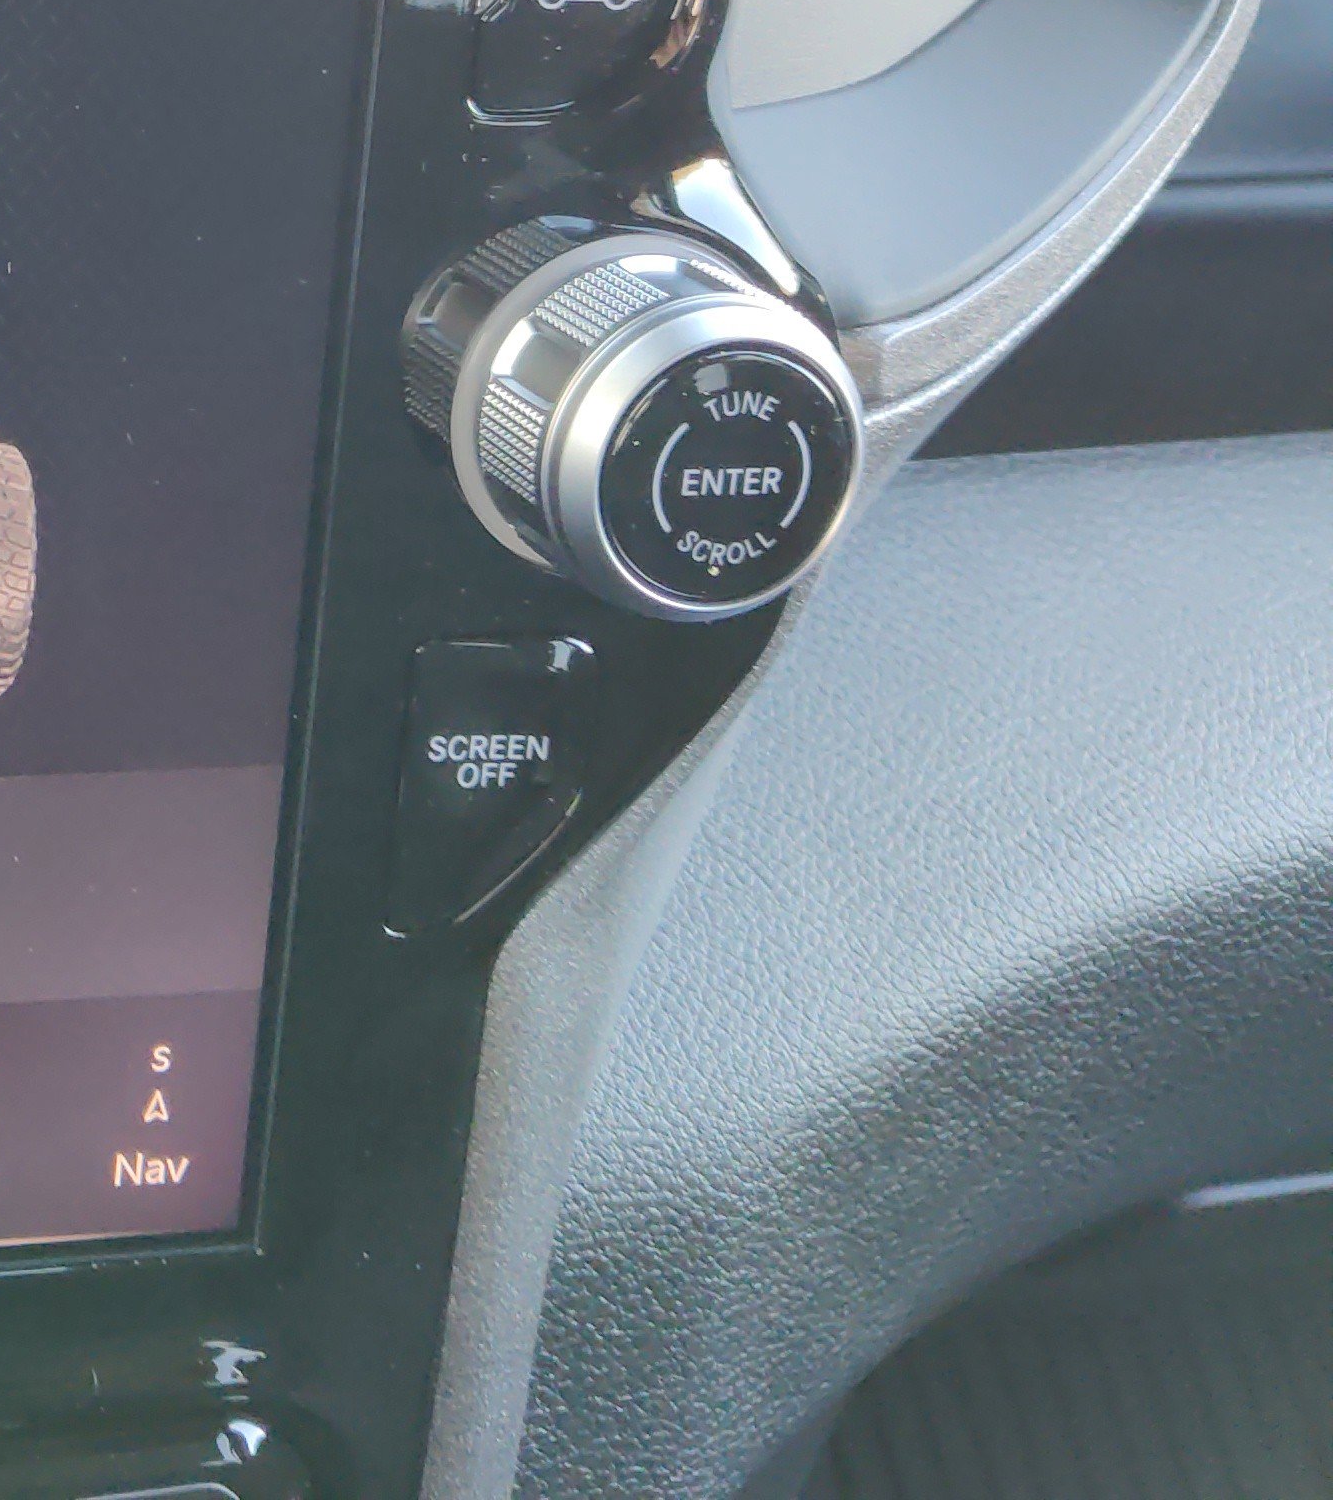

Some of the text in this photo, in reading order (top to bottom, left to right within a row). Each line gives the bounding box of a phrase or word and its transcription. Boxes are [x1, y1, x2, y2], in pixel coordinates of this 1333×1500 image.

[703, 390, 781, 422] TUNE
[681, 467, 783, 497] ENTER
[676, 530, 778, 566] SCROLL
[428, 735, 550, 762] SCREEN
[457, 762, 517, 789] OFF
[151, 1045, 171, 1073] S
[113, 1151, 191, 1187] Nav
